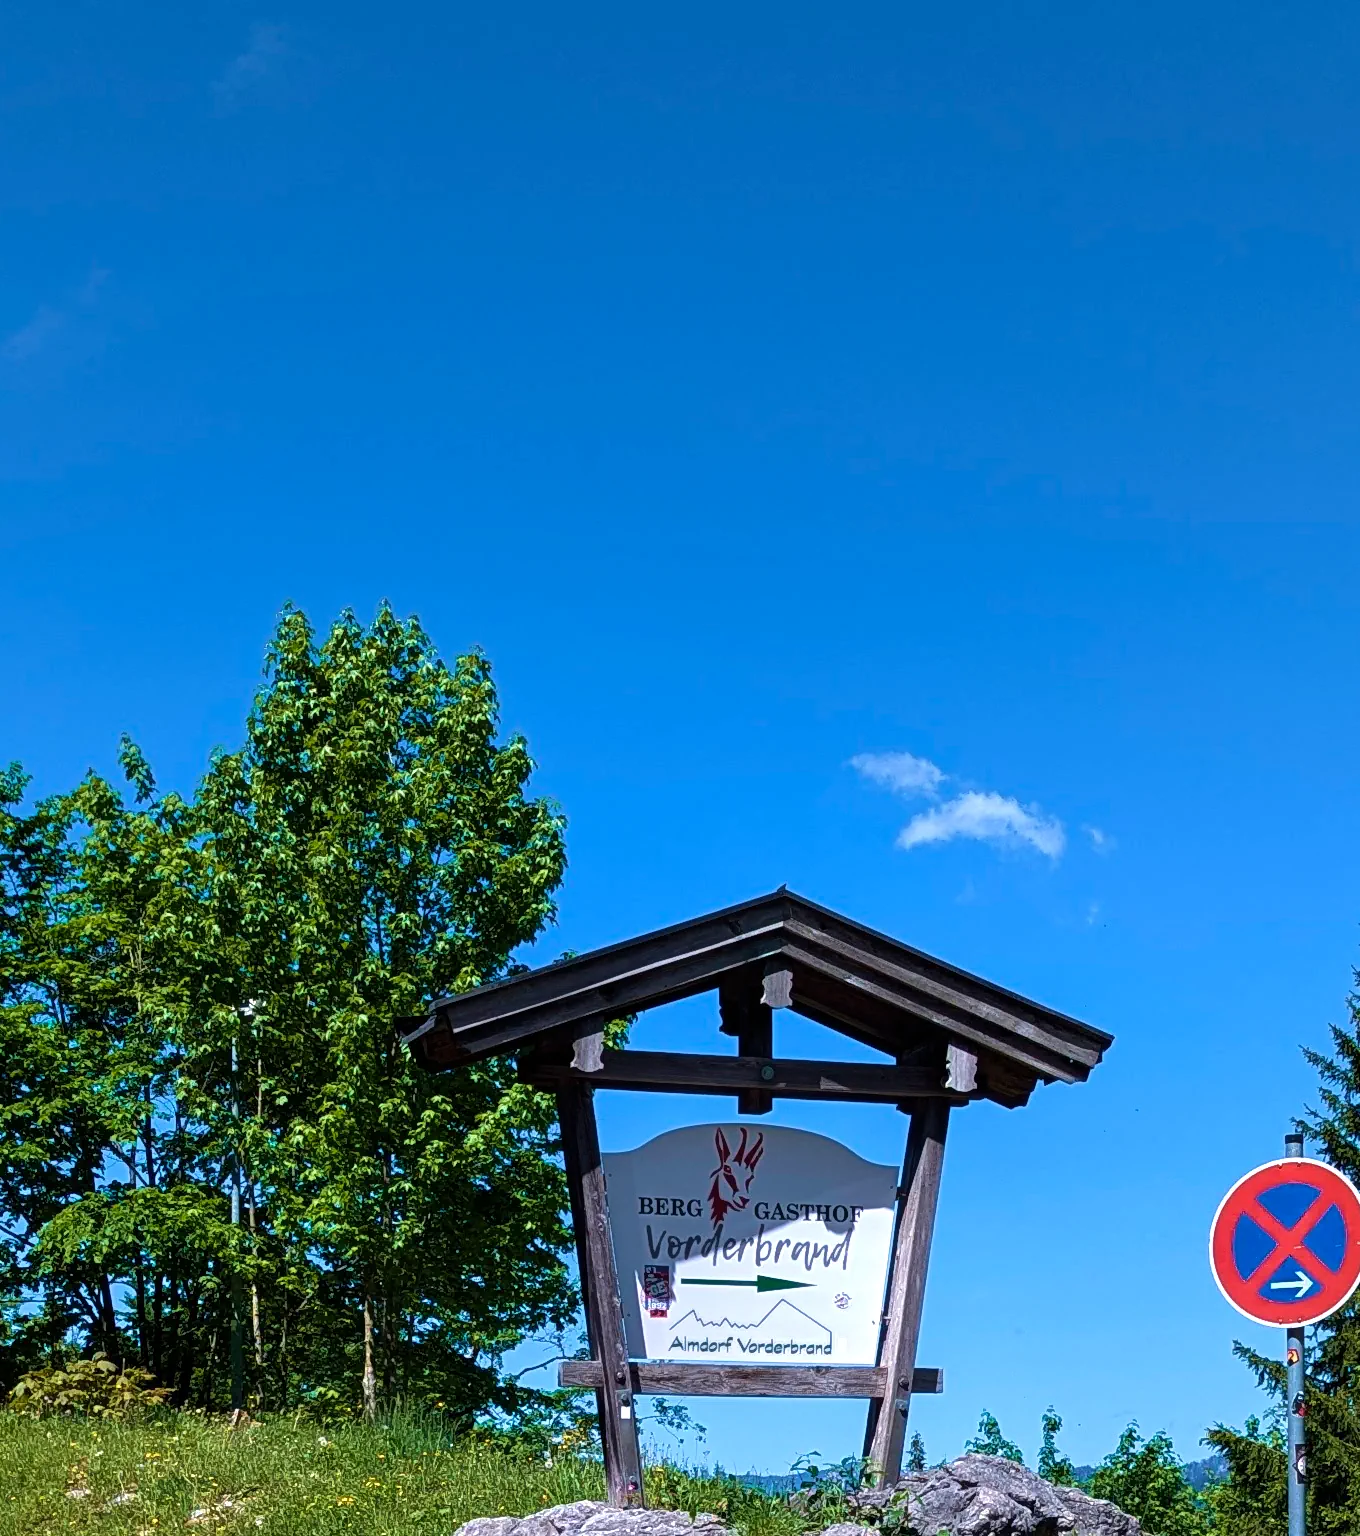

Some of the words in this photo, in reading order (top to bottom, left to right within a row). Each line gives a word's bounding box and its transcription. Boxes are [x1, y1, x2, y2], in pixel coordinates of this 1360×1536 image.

[638, 1196, 704, 1218] BERG
[753, 1201, 864, 1223] GASTHOF
[645, 1223, 853, 1271] Vorderbrand
[668, 1335, 734, 1353] Almdorf
[736, 1336, 833, 1356] Vorderbrand
